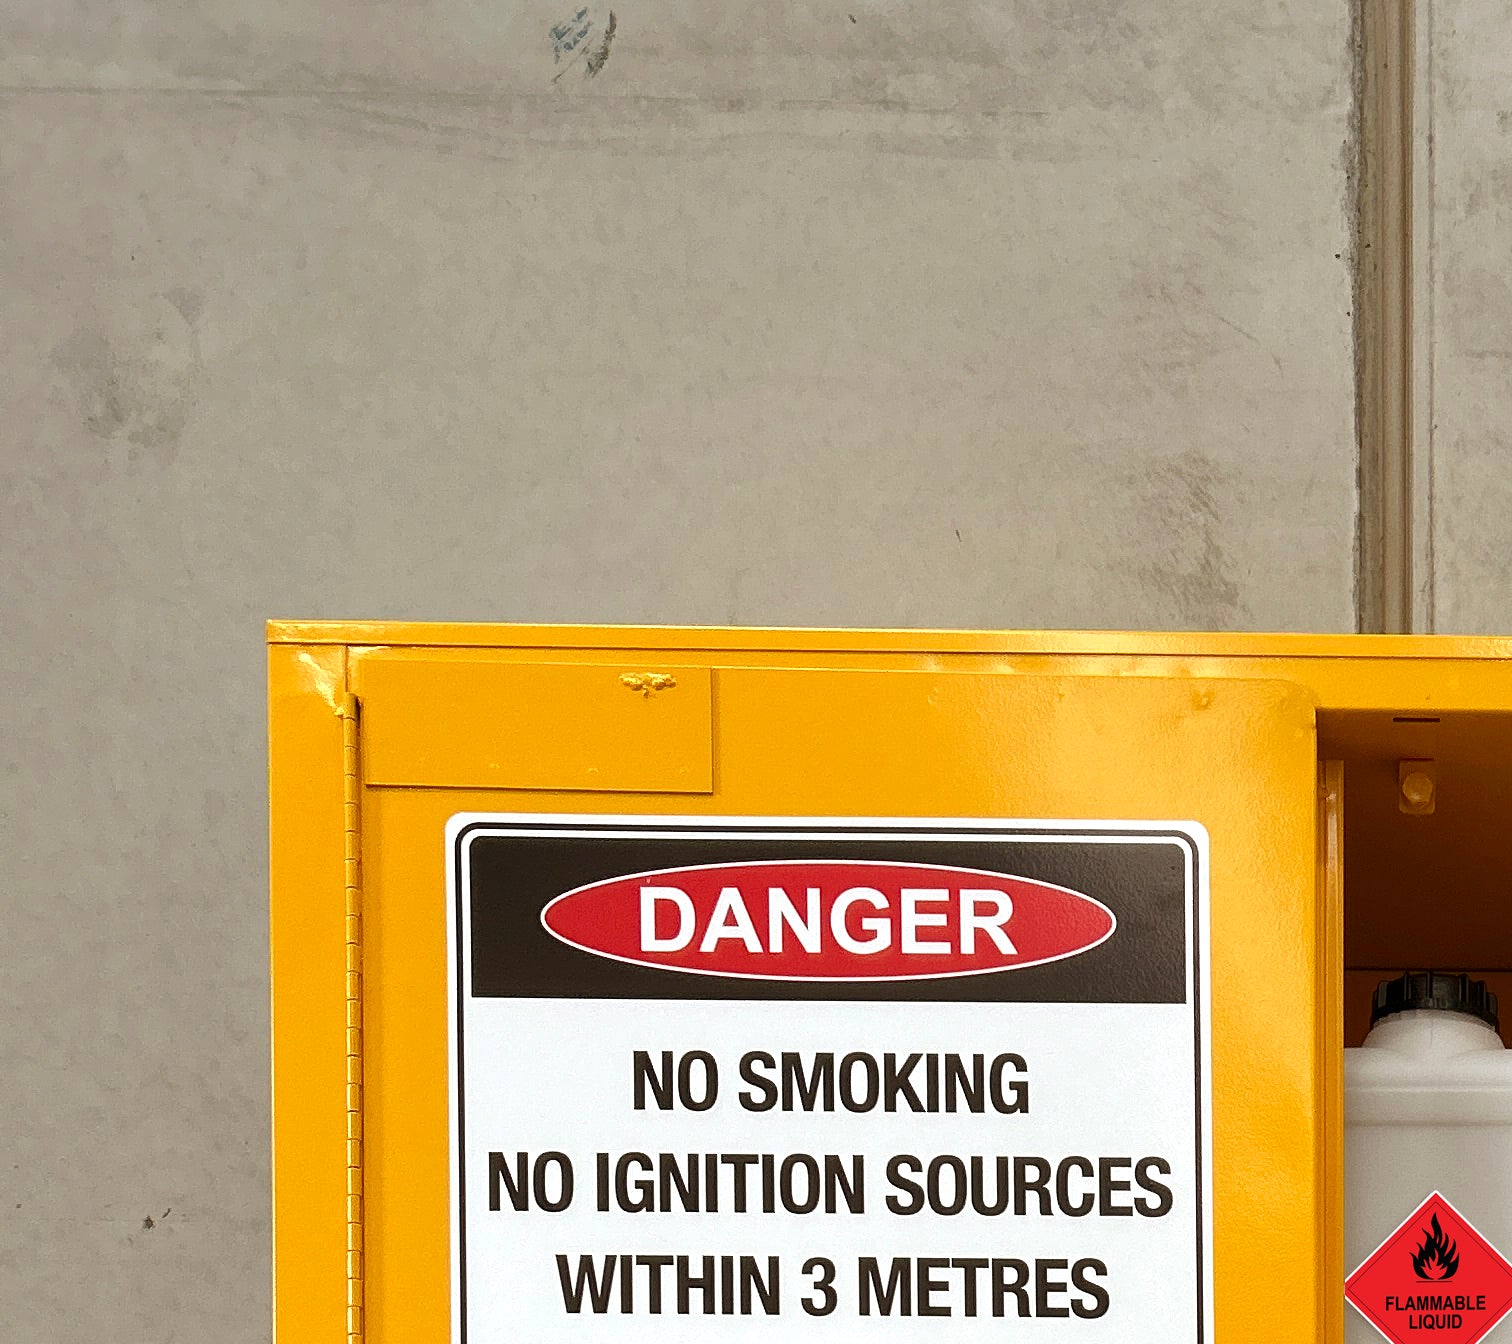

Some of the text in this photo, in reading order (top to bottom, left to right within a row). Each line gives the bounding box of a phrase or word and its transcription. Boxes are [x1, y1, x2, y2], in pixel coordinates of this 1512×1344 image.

[641, 886, 1018, 955] DANGER
[633, 1050, 1030, 1114] NO SMOKING
[488, 1151, 1174, 1217] NO IGNITION SOURCES
[556, 1254, 1111, 1319] WITHIN 3 METRES
[1385, 1296, 1486, 1311] FLAMMABLE
[1408, 1314, 1463, 1330] LIQUID
